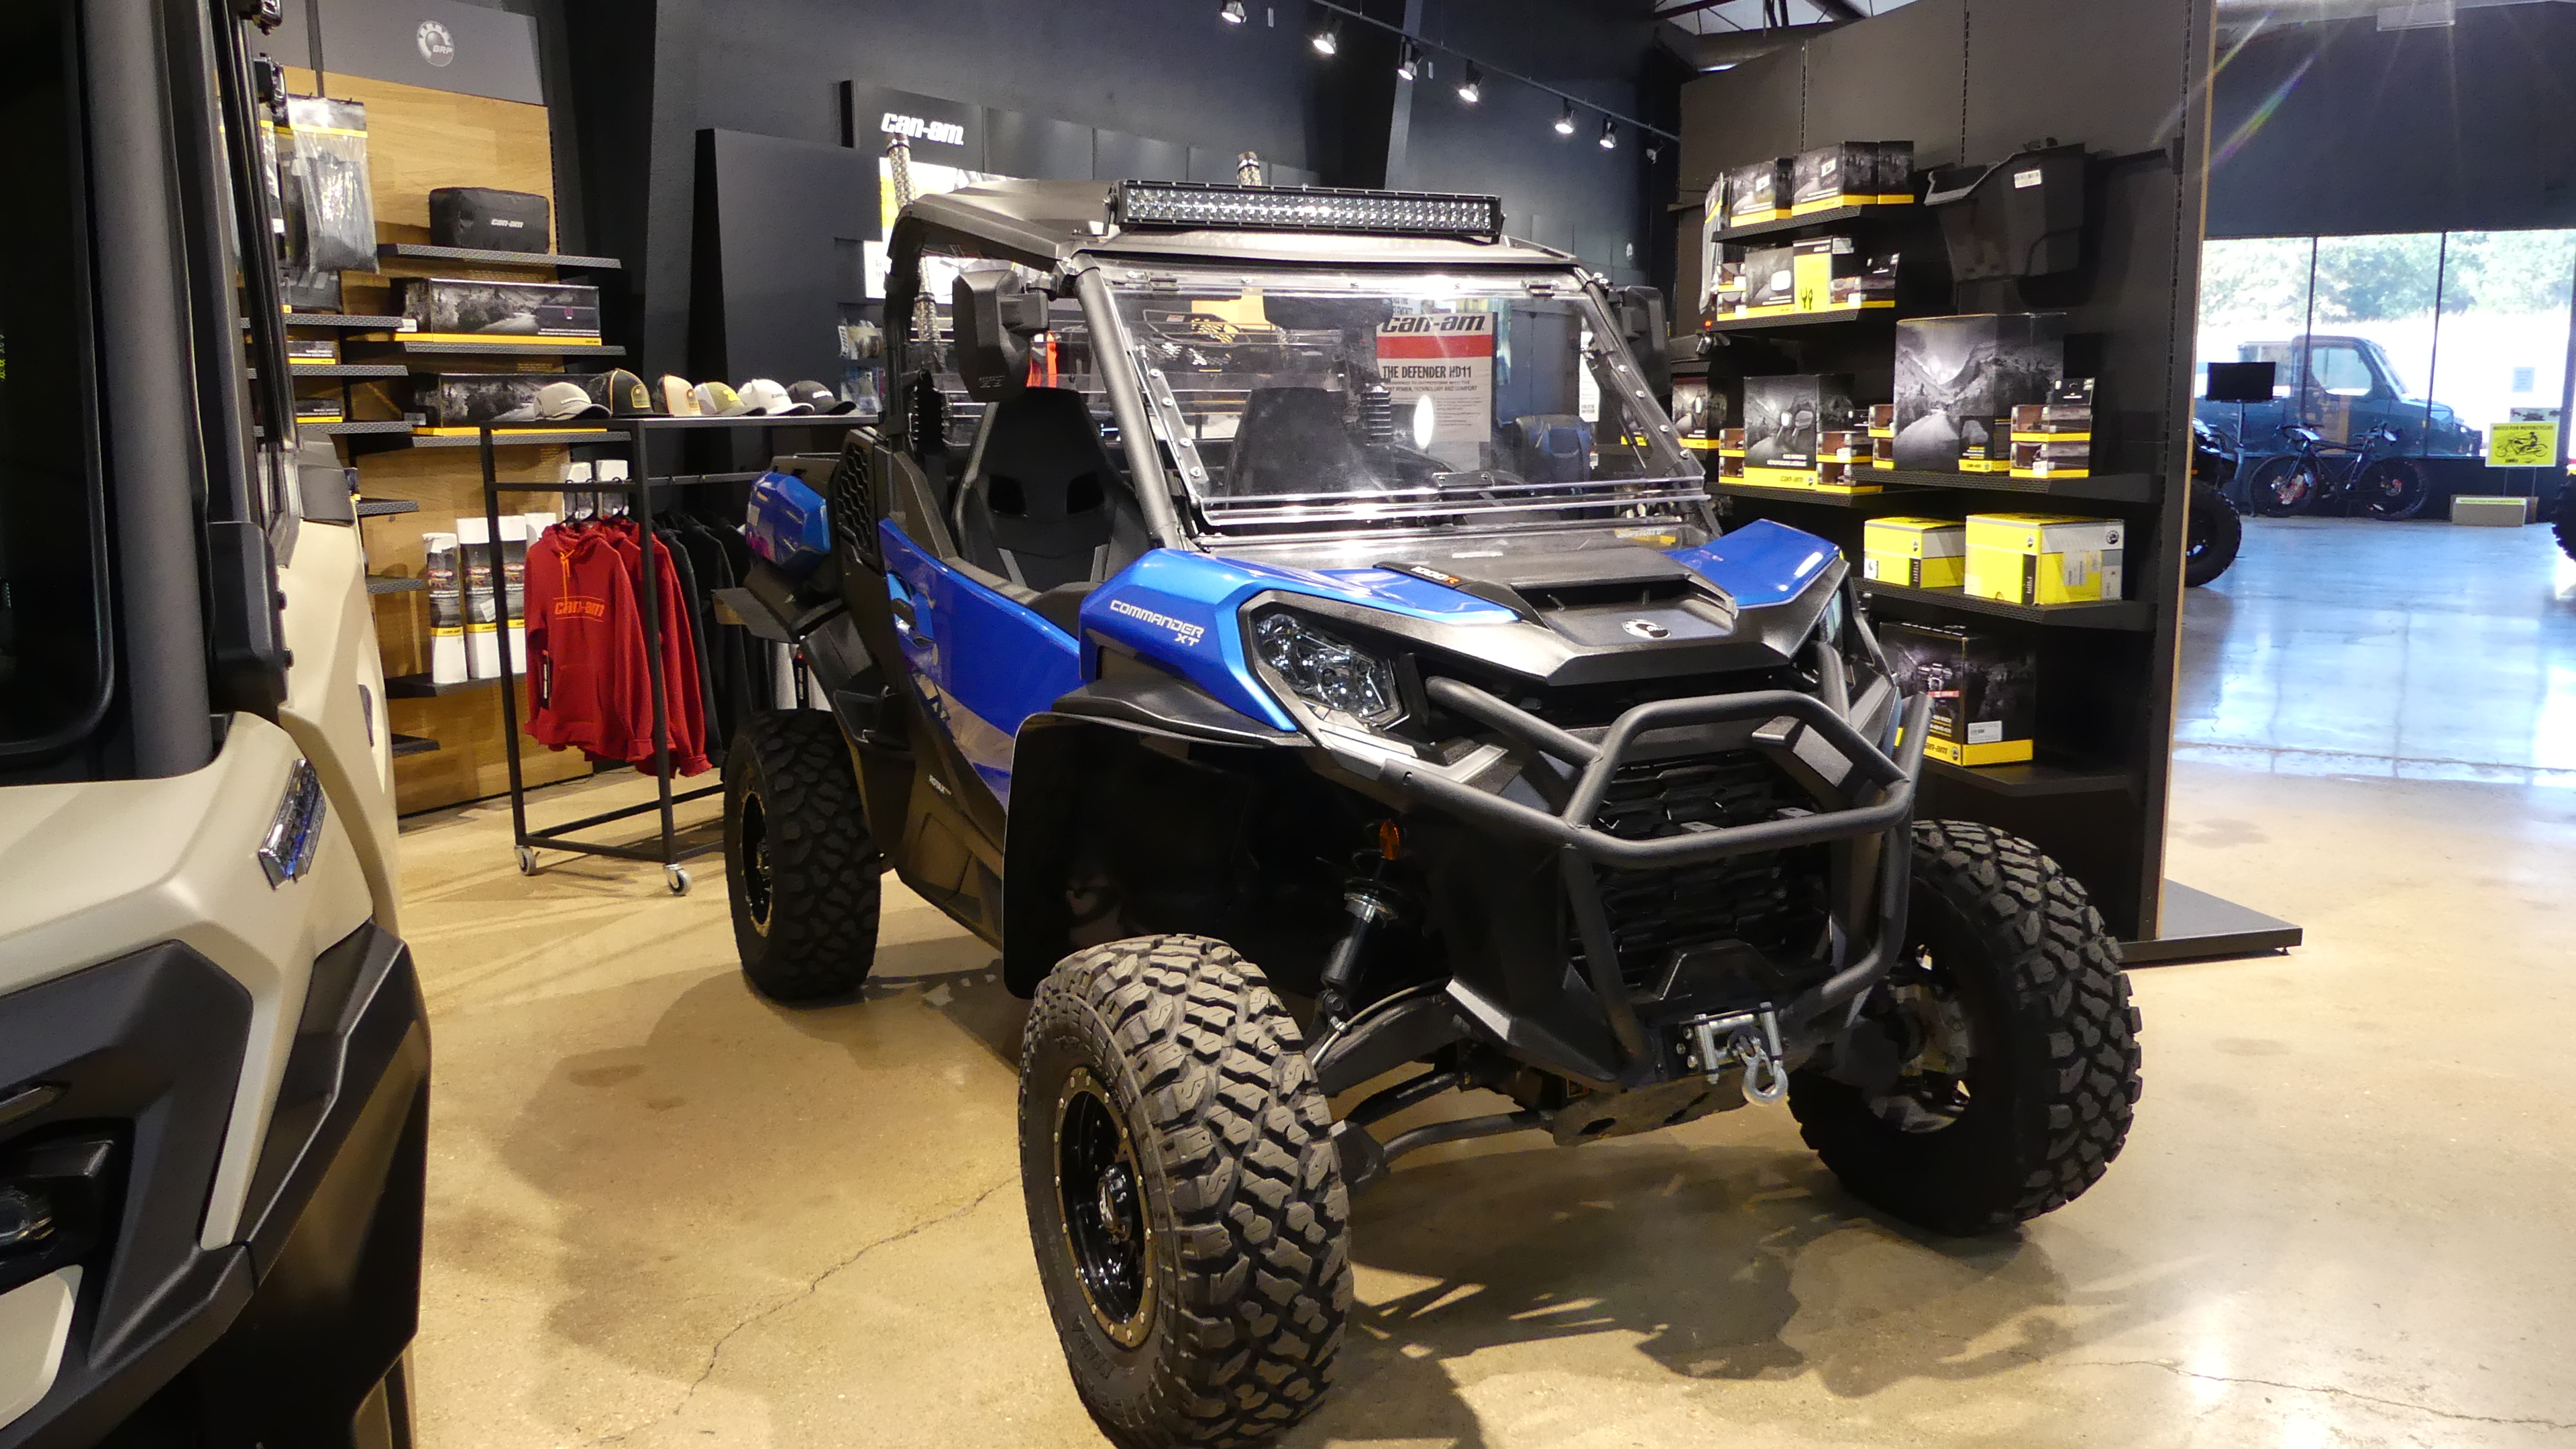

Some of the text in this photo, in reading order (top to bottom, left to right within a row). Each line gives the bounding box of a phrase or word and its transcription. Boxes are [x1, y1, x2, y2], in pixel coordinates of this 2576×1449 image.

[433, 45, 453, 54] BRP
[881, 113, 964, 146] can-am
[1381, 315, 1485, 333] can-am
[1383, 366, 1472, 378] THE DEFENDER HD11
[1410, 566, 1460, 584] 1000R
[554, 600, 605, 617] can-am
[1110, 599, 1205, 638] COMMANDER
[1175, 633, 1199, 646] XT
[1925, 742, 1948, 755] an-am
